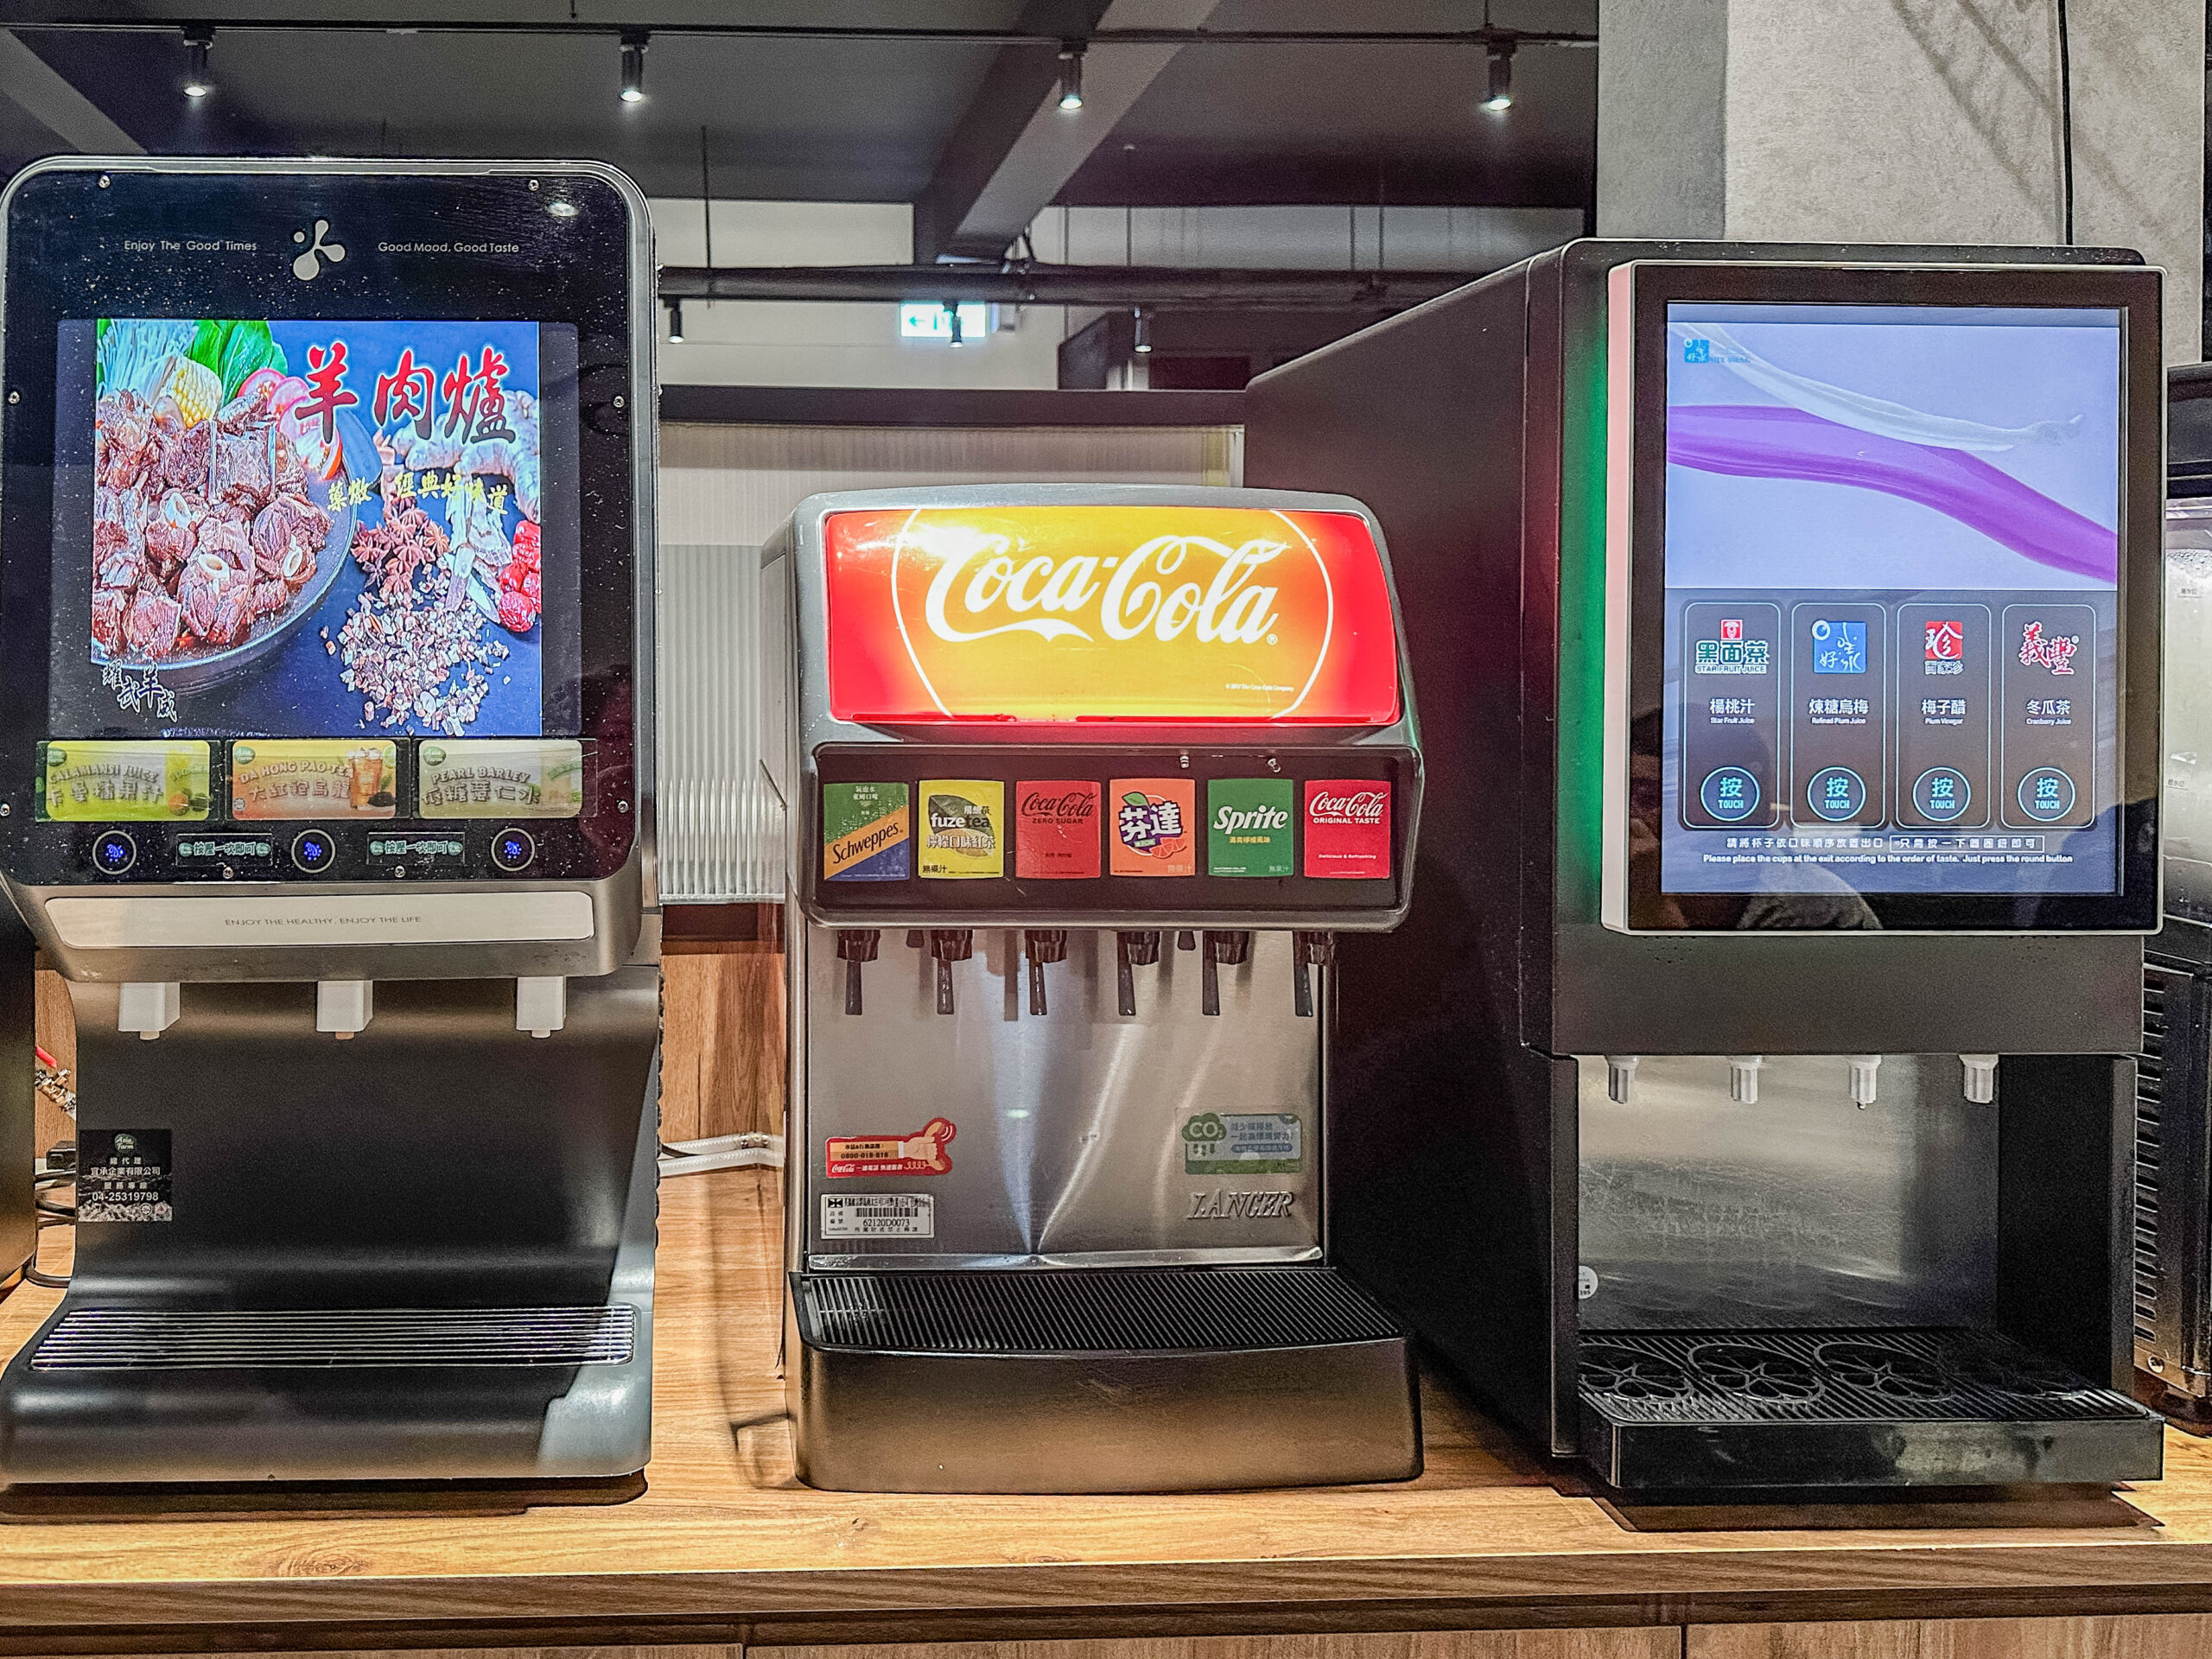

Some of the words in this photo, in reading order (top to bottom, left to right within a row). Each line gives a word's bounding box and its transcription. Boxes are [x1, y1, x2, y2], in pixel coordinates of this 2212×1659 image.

[124, 241, 155, 251] Enjoy
[161, 241, 181, 251] The
[186, 241, 219, 251] Good
[226, 241, 257, 251] Times
[378, 242, 411, 252] Good
[414, 242, 451, 253] Mood,
[454, 242, 487, 252] Good
[490, 243, 519, 252] Taste
[295, 342, 516, 444] 羊肉爐
[925, 528, 1287, 644] Coca-Cola
[1695, 639, 1770, 664] 黑面蔡
[1709, 698, 1755, 715] 楊桃汁
[1921, 699, 1967, 715] 梅子醋
[2026, 699, 2071, 715] 冬瓜茶
[239, 771, 258, 784] DA
[261, 761, 297, 777] HONG
[302, 760, 327, 773] PAO
[329, 765, 354, 779] TEA
[432, 766, 474, 785] PEARL
[477, 766, 531, 784] BARLEY
[1719, 777, 1743, 798] 按
[1826, 777, 1849, 798] 按
[1931, 778, 1955, 798] 按
[2036, 778, 2059, 798] 按
[1021, 791, 1098, 817] Coca-Cola
[1309, 791, 1388, 817] Coca-Cola
[1718, 800, 1744, 810] TOUCH
[1824, 800, 1851, 810] TOUCH
[1929, 800, 1955, 810] TOUCH
[2035, 800, 2061, 810] TOUCH
[1120, 801, 1183, 842] 芬達
[1213, 804, 1288, 835] Sprite
[833, 822, 899, 864] Schweppes
[1732, 855, 1757, 864] place
[1771, 855, 1793, 864] cups
[1834, 855, 1876, 864] according
[1981, 855, 2005, 864] press
[92, 1192, 159, 1201] 04-25319798
[1187, 1189, 1294, 1219] LANCER
[863, 1218, 910, 1227] 62120D0073
